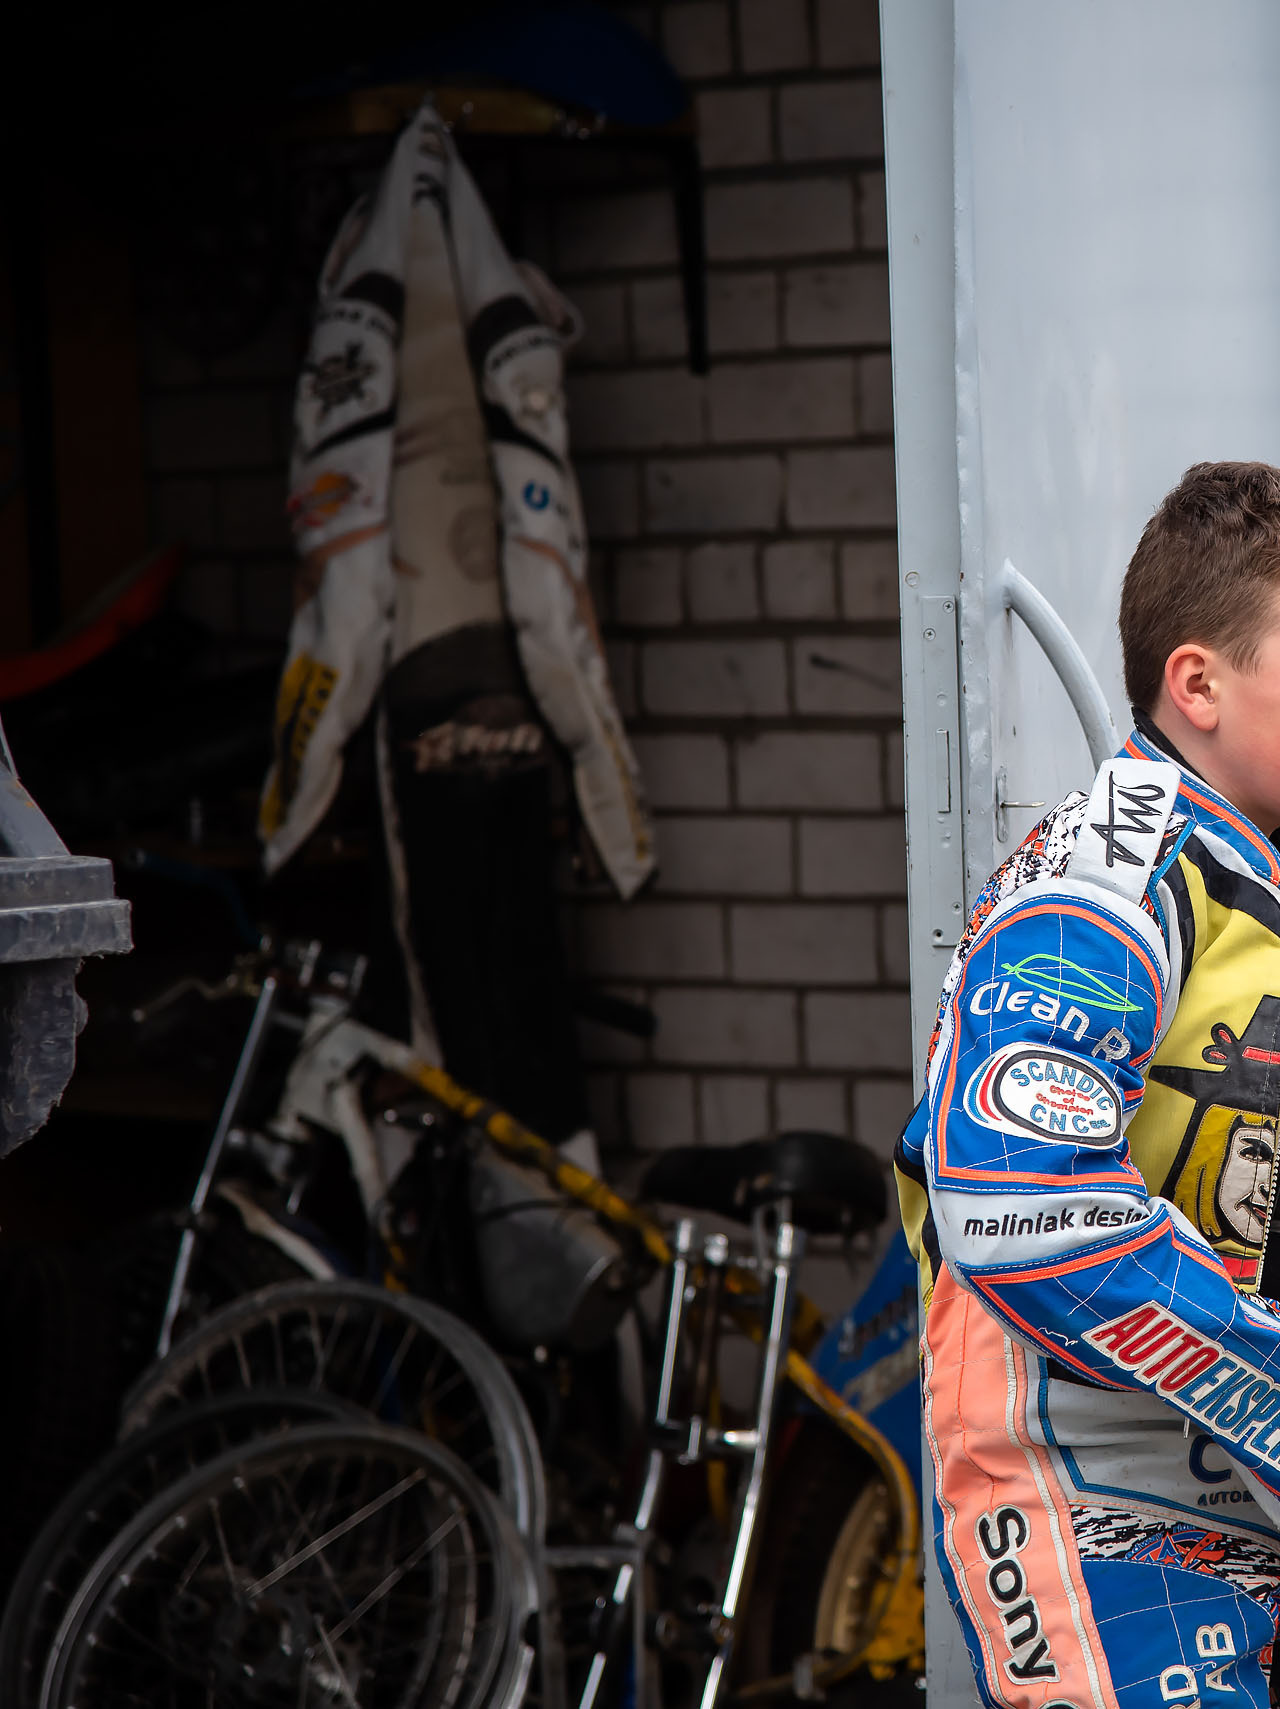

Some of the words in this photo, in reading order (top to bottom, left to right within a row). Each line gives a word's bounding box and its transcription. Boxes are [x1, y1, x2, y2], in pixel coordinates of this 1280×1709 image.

[969, 981, 1090, 1042] Clean
[1010, 1061, 1115, 1111] SCANDIC
[1030, 1103, 1090, 1134] CNC
[964, 1207, 1075, 1238] maliniak
[978, 1506, 1057, 1680] Sony
[1195, 1622, 1237, 1693] AB
